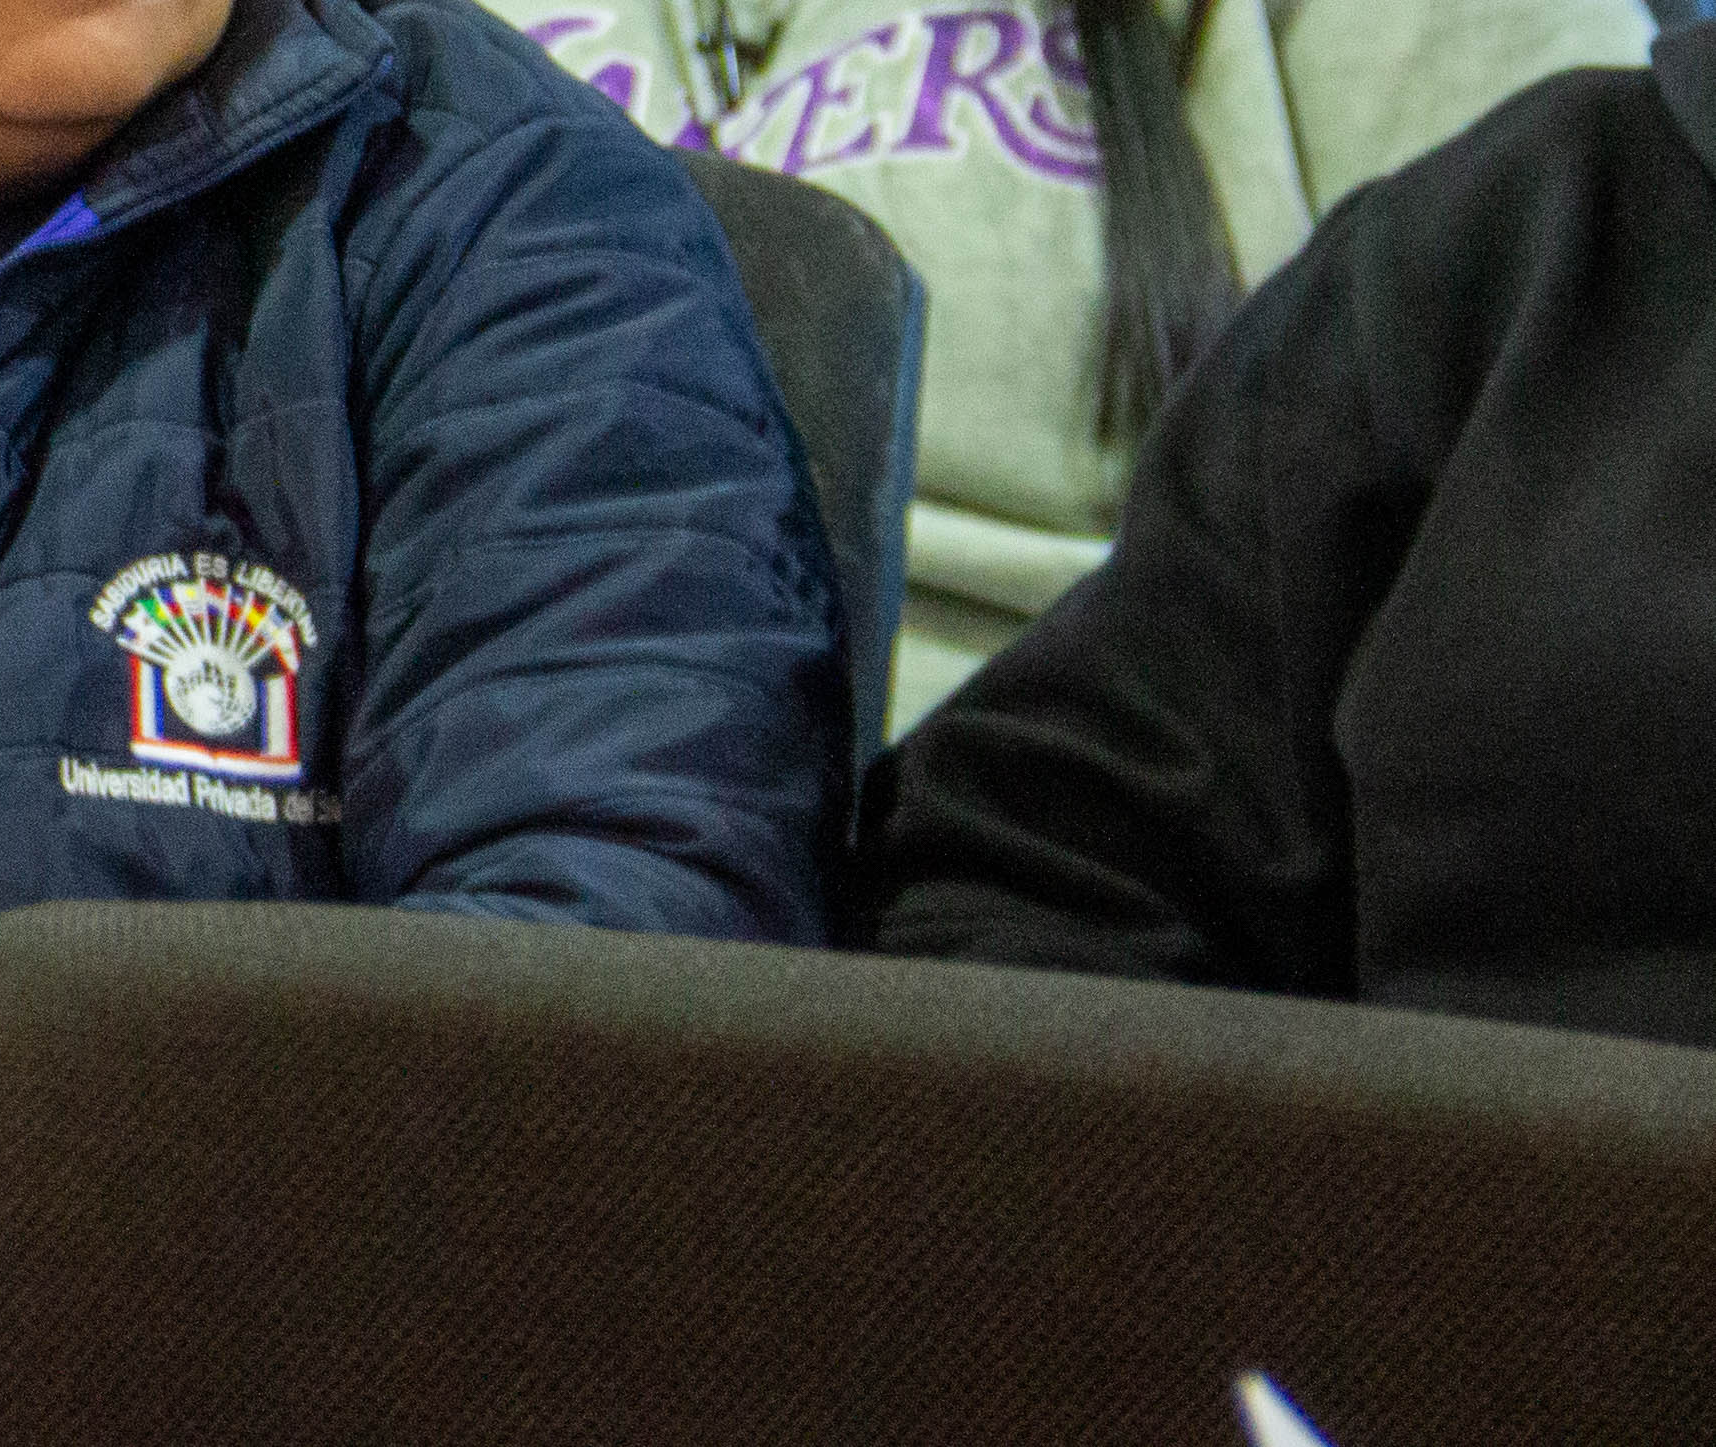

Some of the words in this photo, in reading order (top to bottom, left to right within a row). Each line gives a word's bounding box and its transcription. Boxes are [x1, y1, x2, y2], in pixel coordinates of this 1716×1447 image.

[194, 552, 229, 579] ES
[59, 757, 190, 807] Universidad
[192, 772, 278, 823] Privada
[283, 789, 314, 825] del
